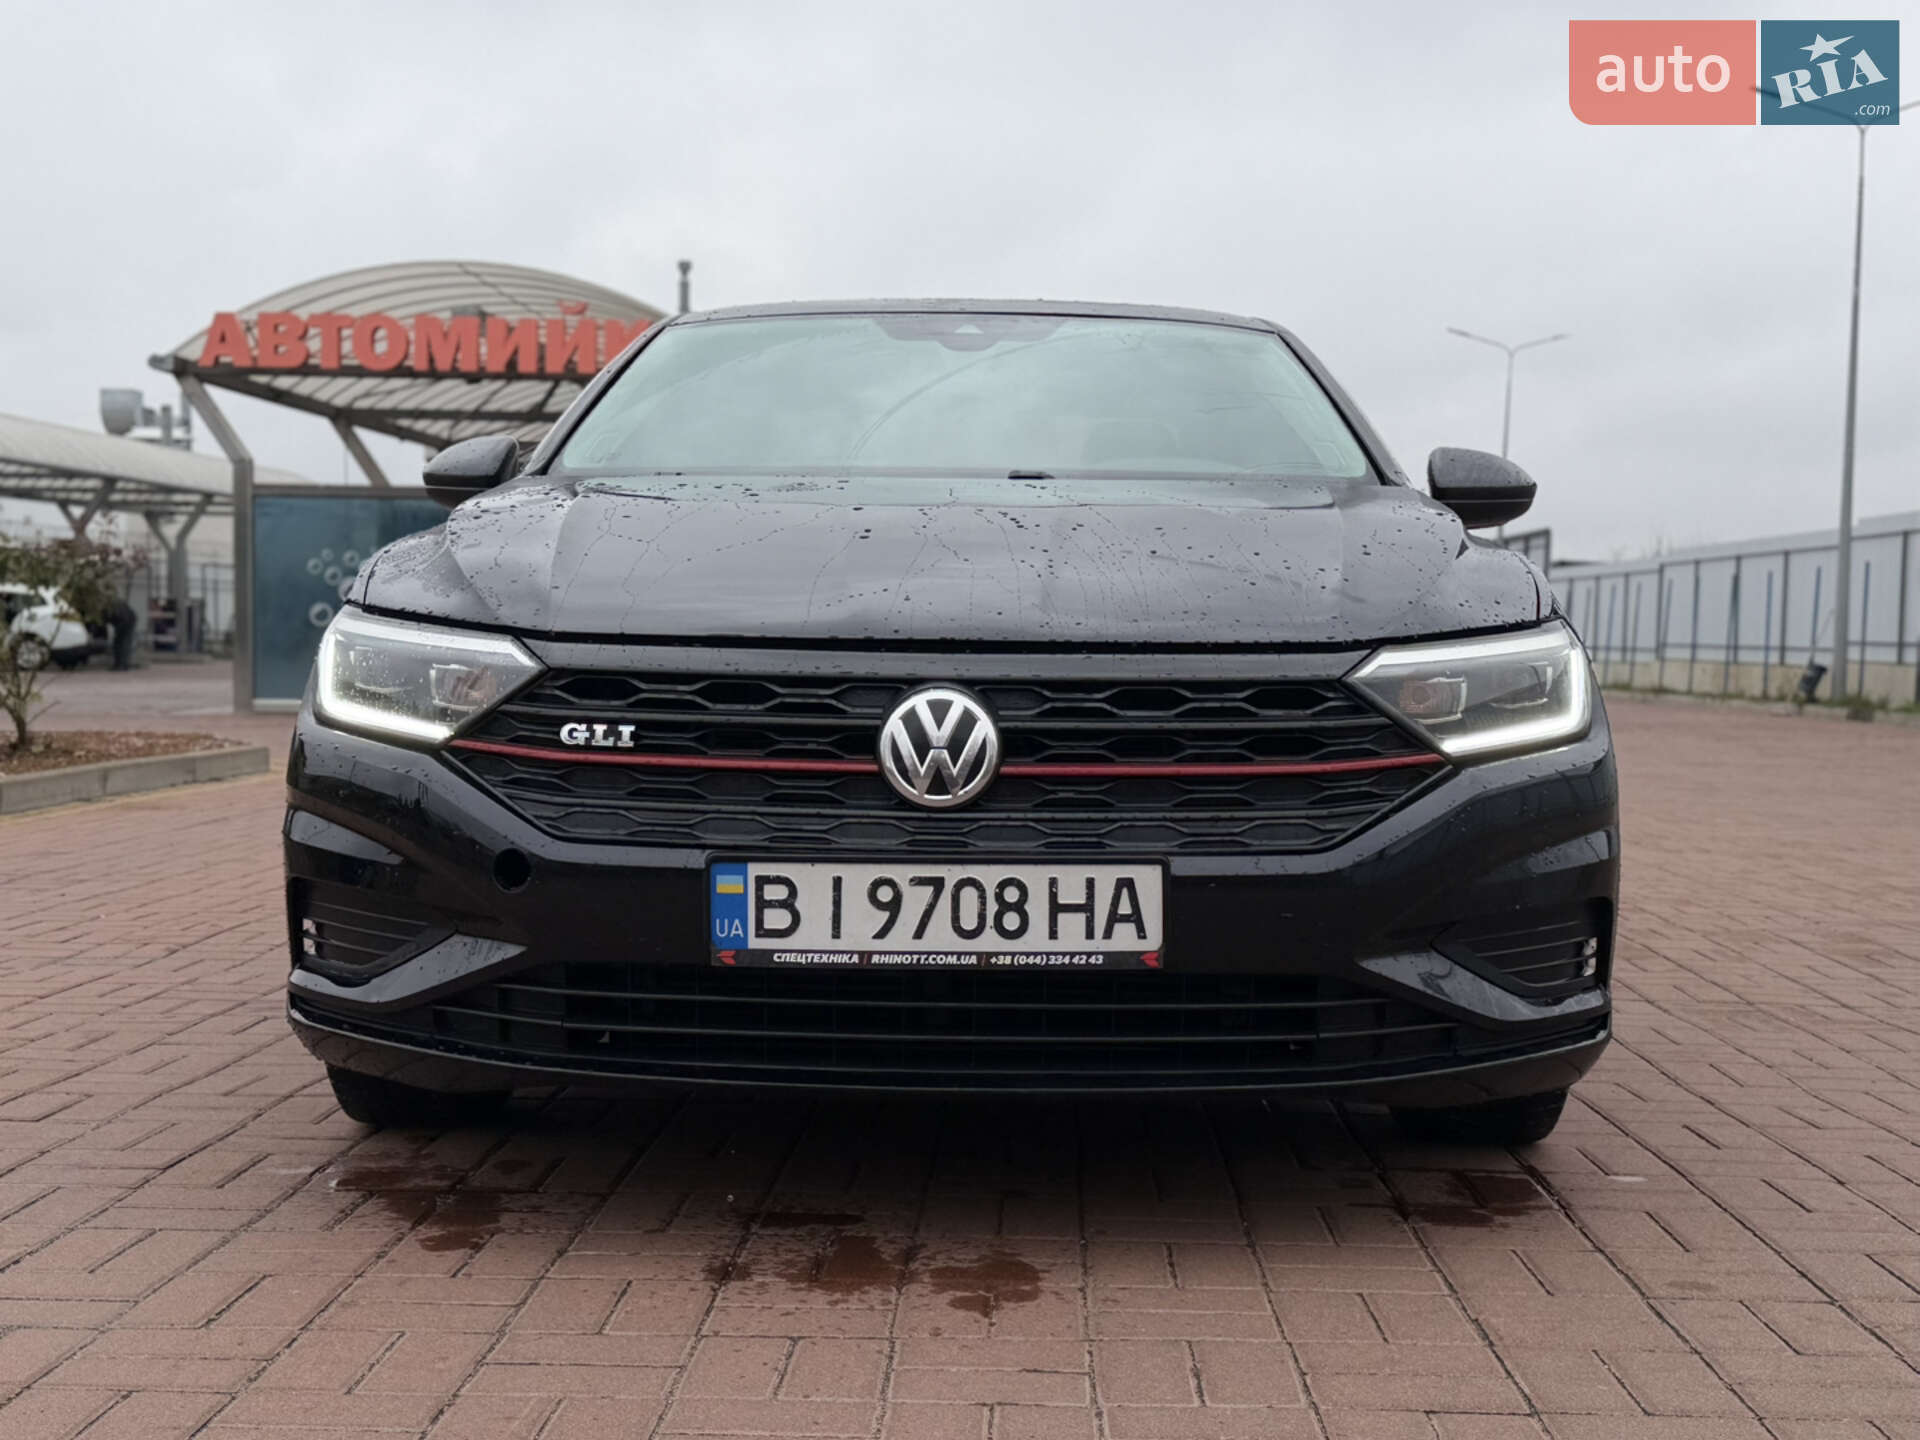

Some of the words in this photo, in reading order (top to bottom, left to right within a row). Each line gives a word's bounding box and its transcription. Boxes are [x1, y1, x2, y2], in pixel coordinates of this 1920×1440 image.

[559, 723, 636, 748] GLI
[716, 918, 744, 938] UA
[871, 953, 977, 965] RHINOTT.COM.UA
